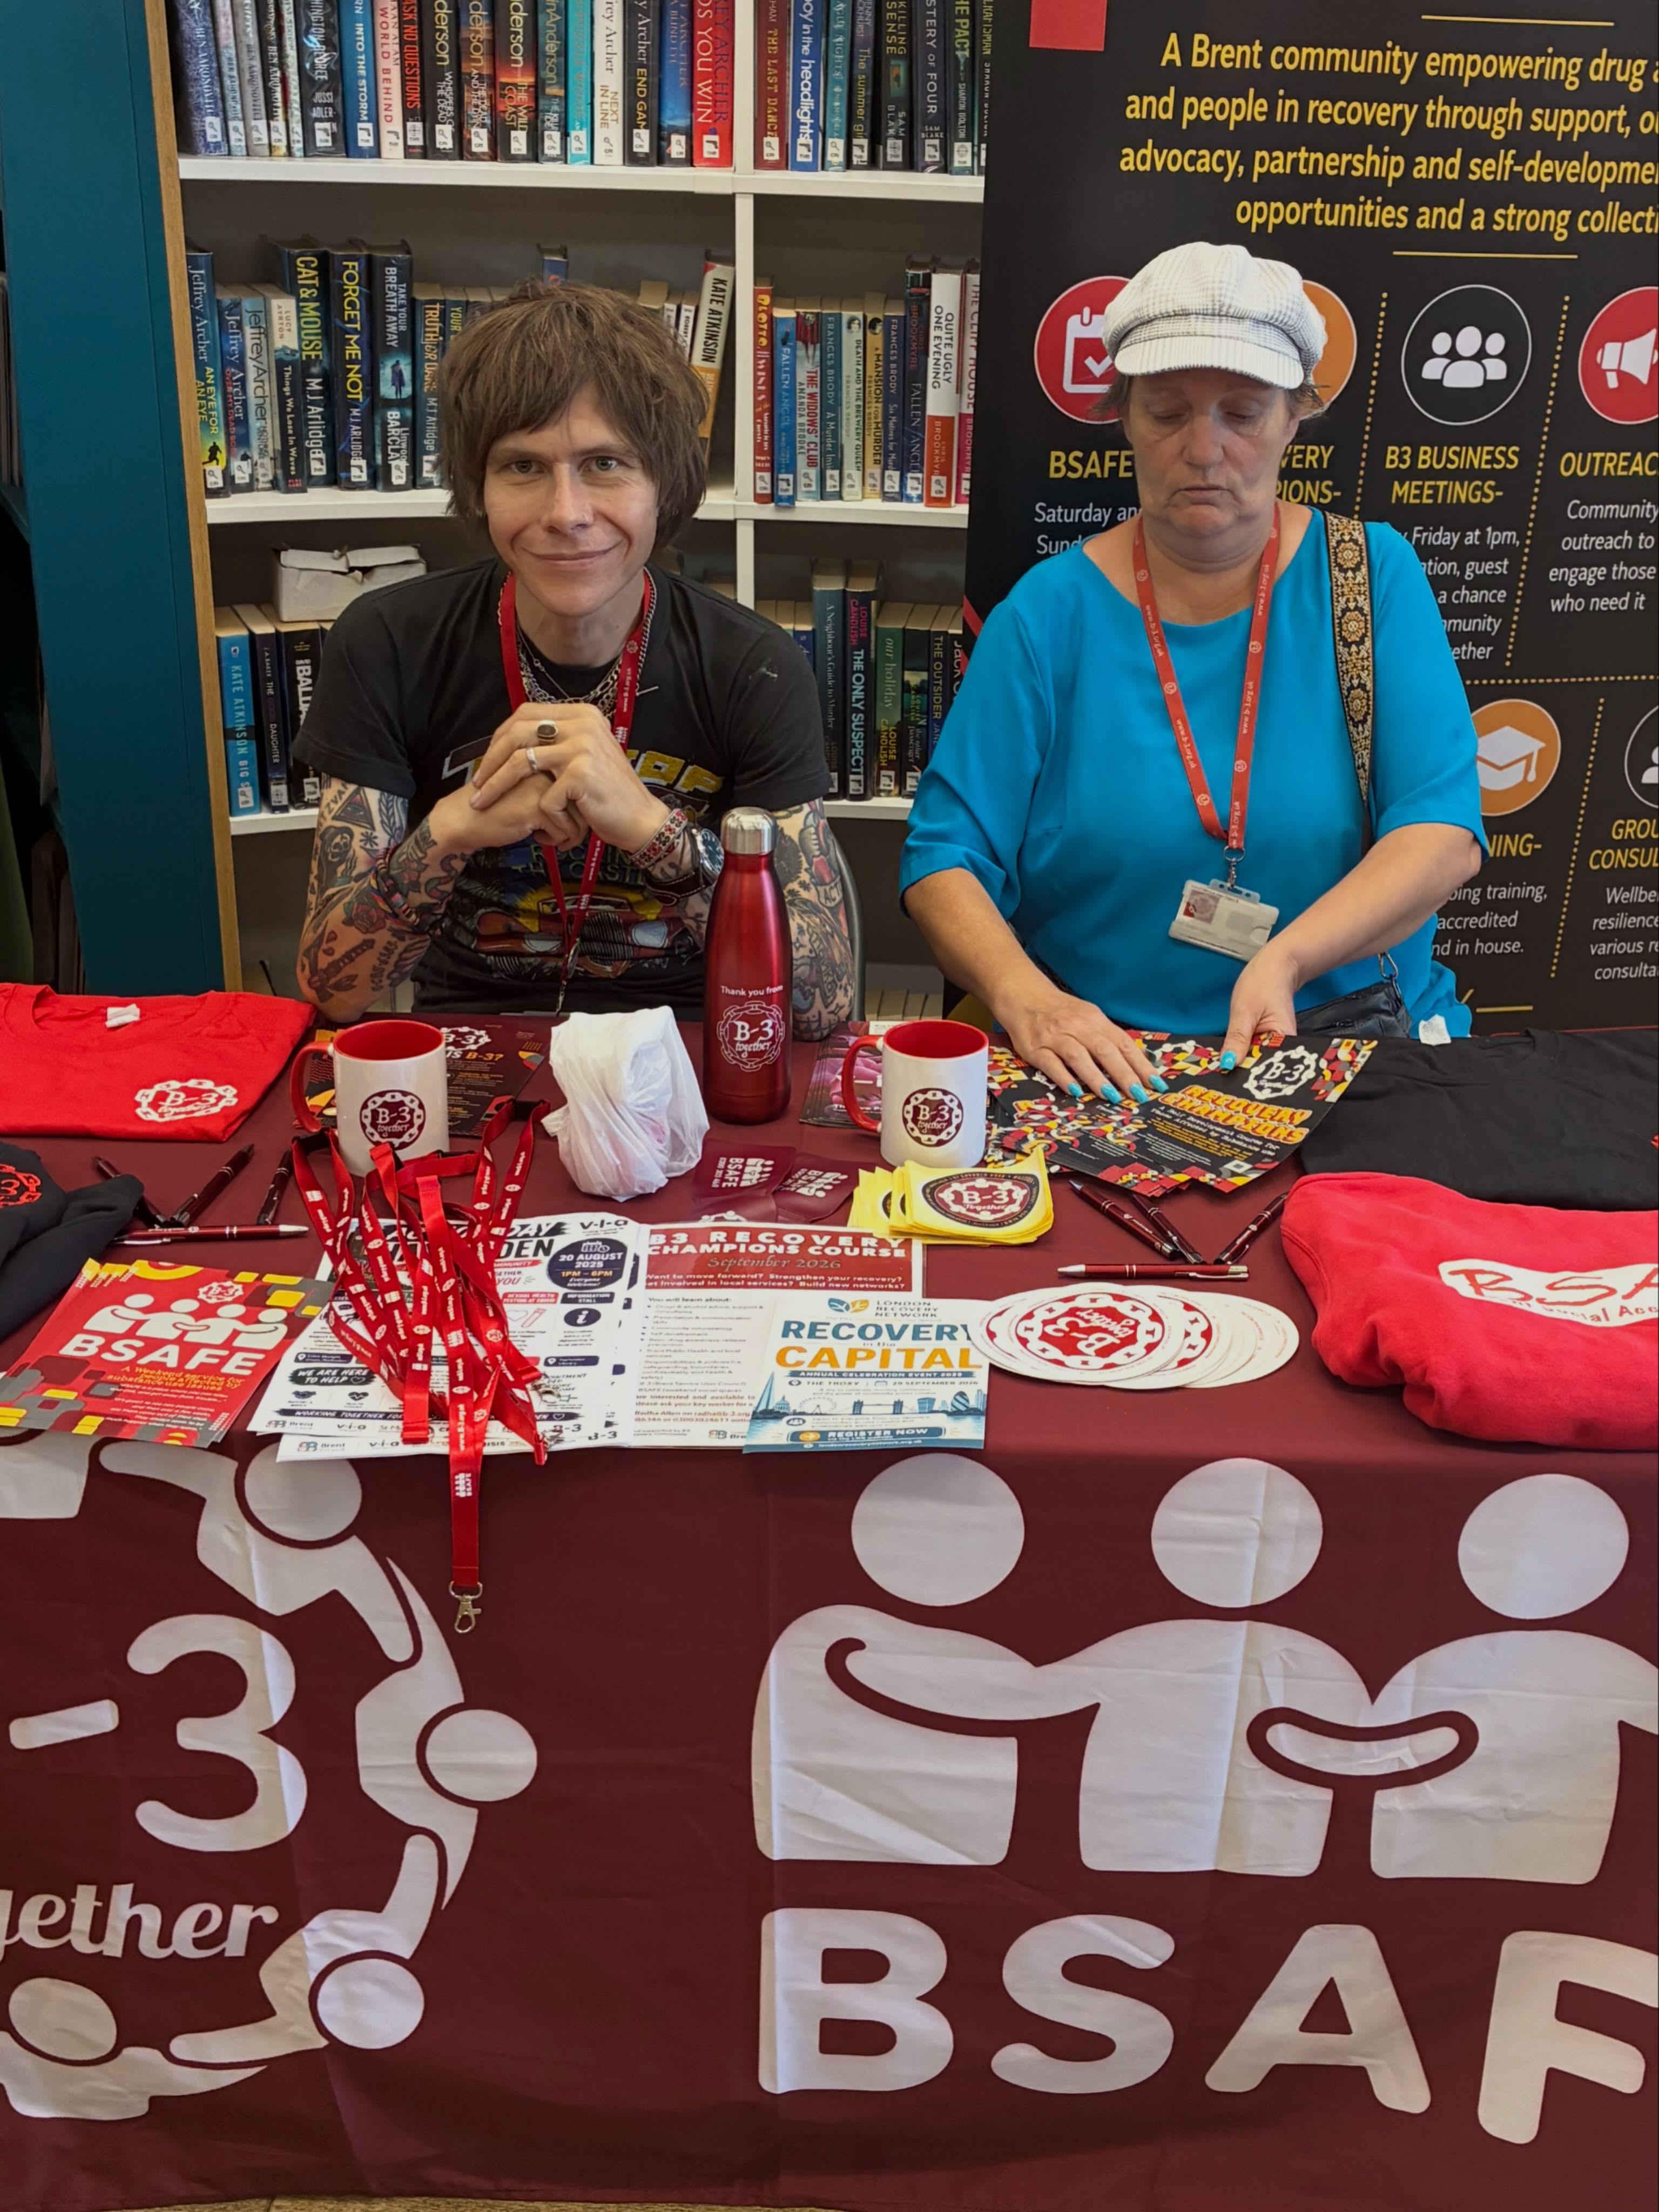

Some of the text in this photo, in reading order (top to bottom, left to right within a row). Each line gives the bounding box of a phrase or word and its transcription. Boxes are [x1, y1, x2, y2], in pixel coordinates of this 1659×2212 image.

[379, 8, 394, 123] WORLD BEHIND
[605, 26, 617, 73] Archer
[637, 13, 651, 97] Archer END
[767, 28, 778, 93] THE LAST
[1160, 32, 1182, 67] A
[1191, 33, 1263, 69] Brent
[1270, 41, 1418, 84] community
[1425, 46, 1583, 91] empowering
[1589, 48, 1648, 92] drug
[355, 23, 368, 120] INTO THE STORM
[405, 46, 421, 109] QUESTIONS
[697, 28, 713, 123] YOU WIN
[714, 36, 729, 123] ARCHER
[601, 85, 609, 129] IN LINE
[927, 73, 938, 113] FOUR
[1125, 86, 1175, 120] and
[1182, 87, 1268, 131] people
[1276, 89, 1299, 123] in
[1307, 98, 1419, 136] recovery
[1426, 95, 1523, 140] through
[1530, 105, 1630, 141] support,
[1120, 139, 1462, 187] advocacy, partnership and
[1237, 196, 1572, 241] opportunities and a strong
[188, 265, 211, 361] Jeffrey Archer
[296, 257, 323, 360] CAT & MOUSE
[385, 267, 398, 348] BREATH AWAY
[398, 307, 407, 332] YOUR
[701, 277, 728, 363] KATE ATKINSON
[342, 261, 363, 402] FORGET ME NOT
[889, 319, 898, 360] FRANCES
[932, 305, 943, 390] ONE EVENING
[943, 312, 954, 383] QUITE UGLY
[207, 387, 219, 434] EYE FOR
[231, 368, 246, 419] Archer
[873, 353, 882, 466] MANSION MURDER
[282, 366, 298, 475] Things Waves
[806, 369, 819, 468] THE WIDOWS' CLUB
[1385, 446, 1520, 470] B3 BUSINESS
[1392, 481, 1503, 504] MEETINGS-
[1567, 499, 1658, 523] Community
[1034, 502, 1112, 527] Saturday
[1412, 527, 1460, 550] Friday
[1464, 529, 1480, 545] at
[1487, 527, 1520, 549] 1pm,
[1562, 530, 1655, 550] outreach to
[1465, 558, 1509, 580] guest
[1549, 561, 1656, 587] engage those
[1438, 585, 1507, 604] a chance
[1550, 591, 1645, 612] who need it
[885, 662, 896, 708] holiday
[932, 635, 943, 720] THE OUTSIDER
[231, 665, 249, 778] KATE ATKINSON BIG
[851, 649, 865, 775] THE ONLY SUSPECT
[270, 724, 280, 764] DAUGHTER
[879, 719, 888, 767] CANDLISH
[1487, 882, 1547, 903] training,
[1438, 911, 1519, 929] accredited
[1455, 939, 1524, 954] in house.
[1590, 939, 1644, 955] various
[720, 985, 783, 997] Thank you from
[733, 1019, 773, 1041] B-3
[735, 1041, 772, 1057] together
[1263, 1061, 1305, 1082] B-3
[376, 1107, 411, 1124] B-3
[917, 1104, 949, 1121] B-3
[1158, 1092, 1310, 1145] CHAMPIONS
[1179, 1085, 1313, 1126] RECOVERY
[377, 1123, 409, 1138] together
[918, 1120, 948, 1133] together
[721, 1157, 745, 1188] BSAFE
[962, 1190, 1009, 1204] B-3
[576, 1252, 624, 1261] AUGUST
[648, 1243, 906, 1257] CHAMPIONS COURSE
[650, 1231, 905, 1248] B3 RECOVERY
[708, 1254, 841, 1272] September 2026
[59, 1333, 266, 1376] BSAFE
[134, 1366, 184, 1378] Weekend
[775, 1346, 982, 1369] CAPITAL
[322, 1376, 348, 1384] HELP
[828, 1429, 892, 1438] REGISTER
